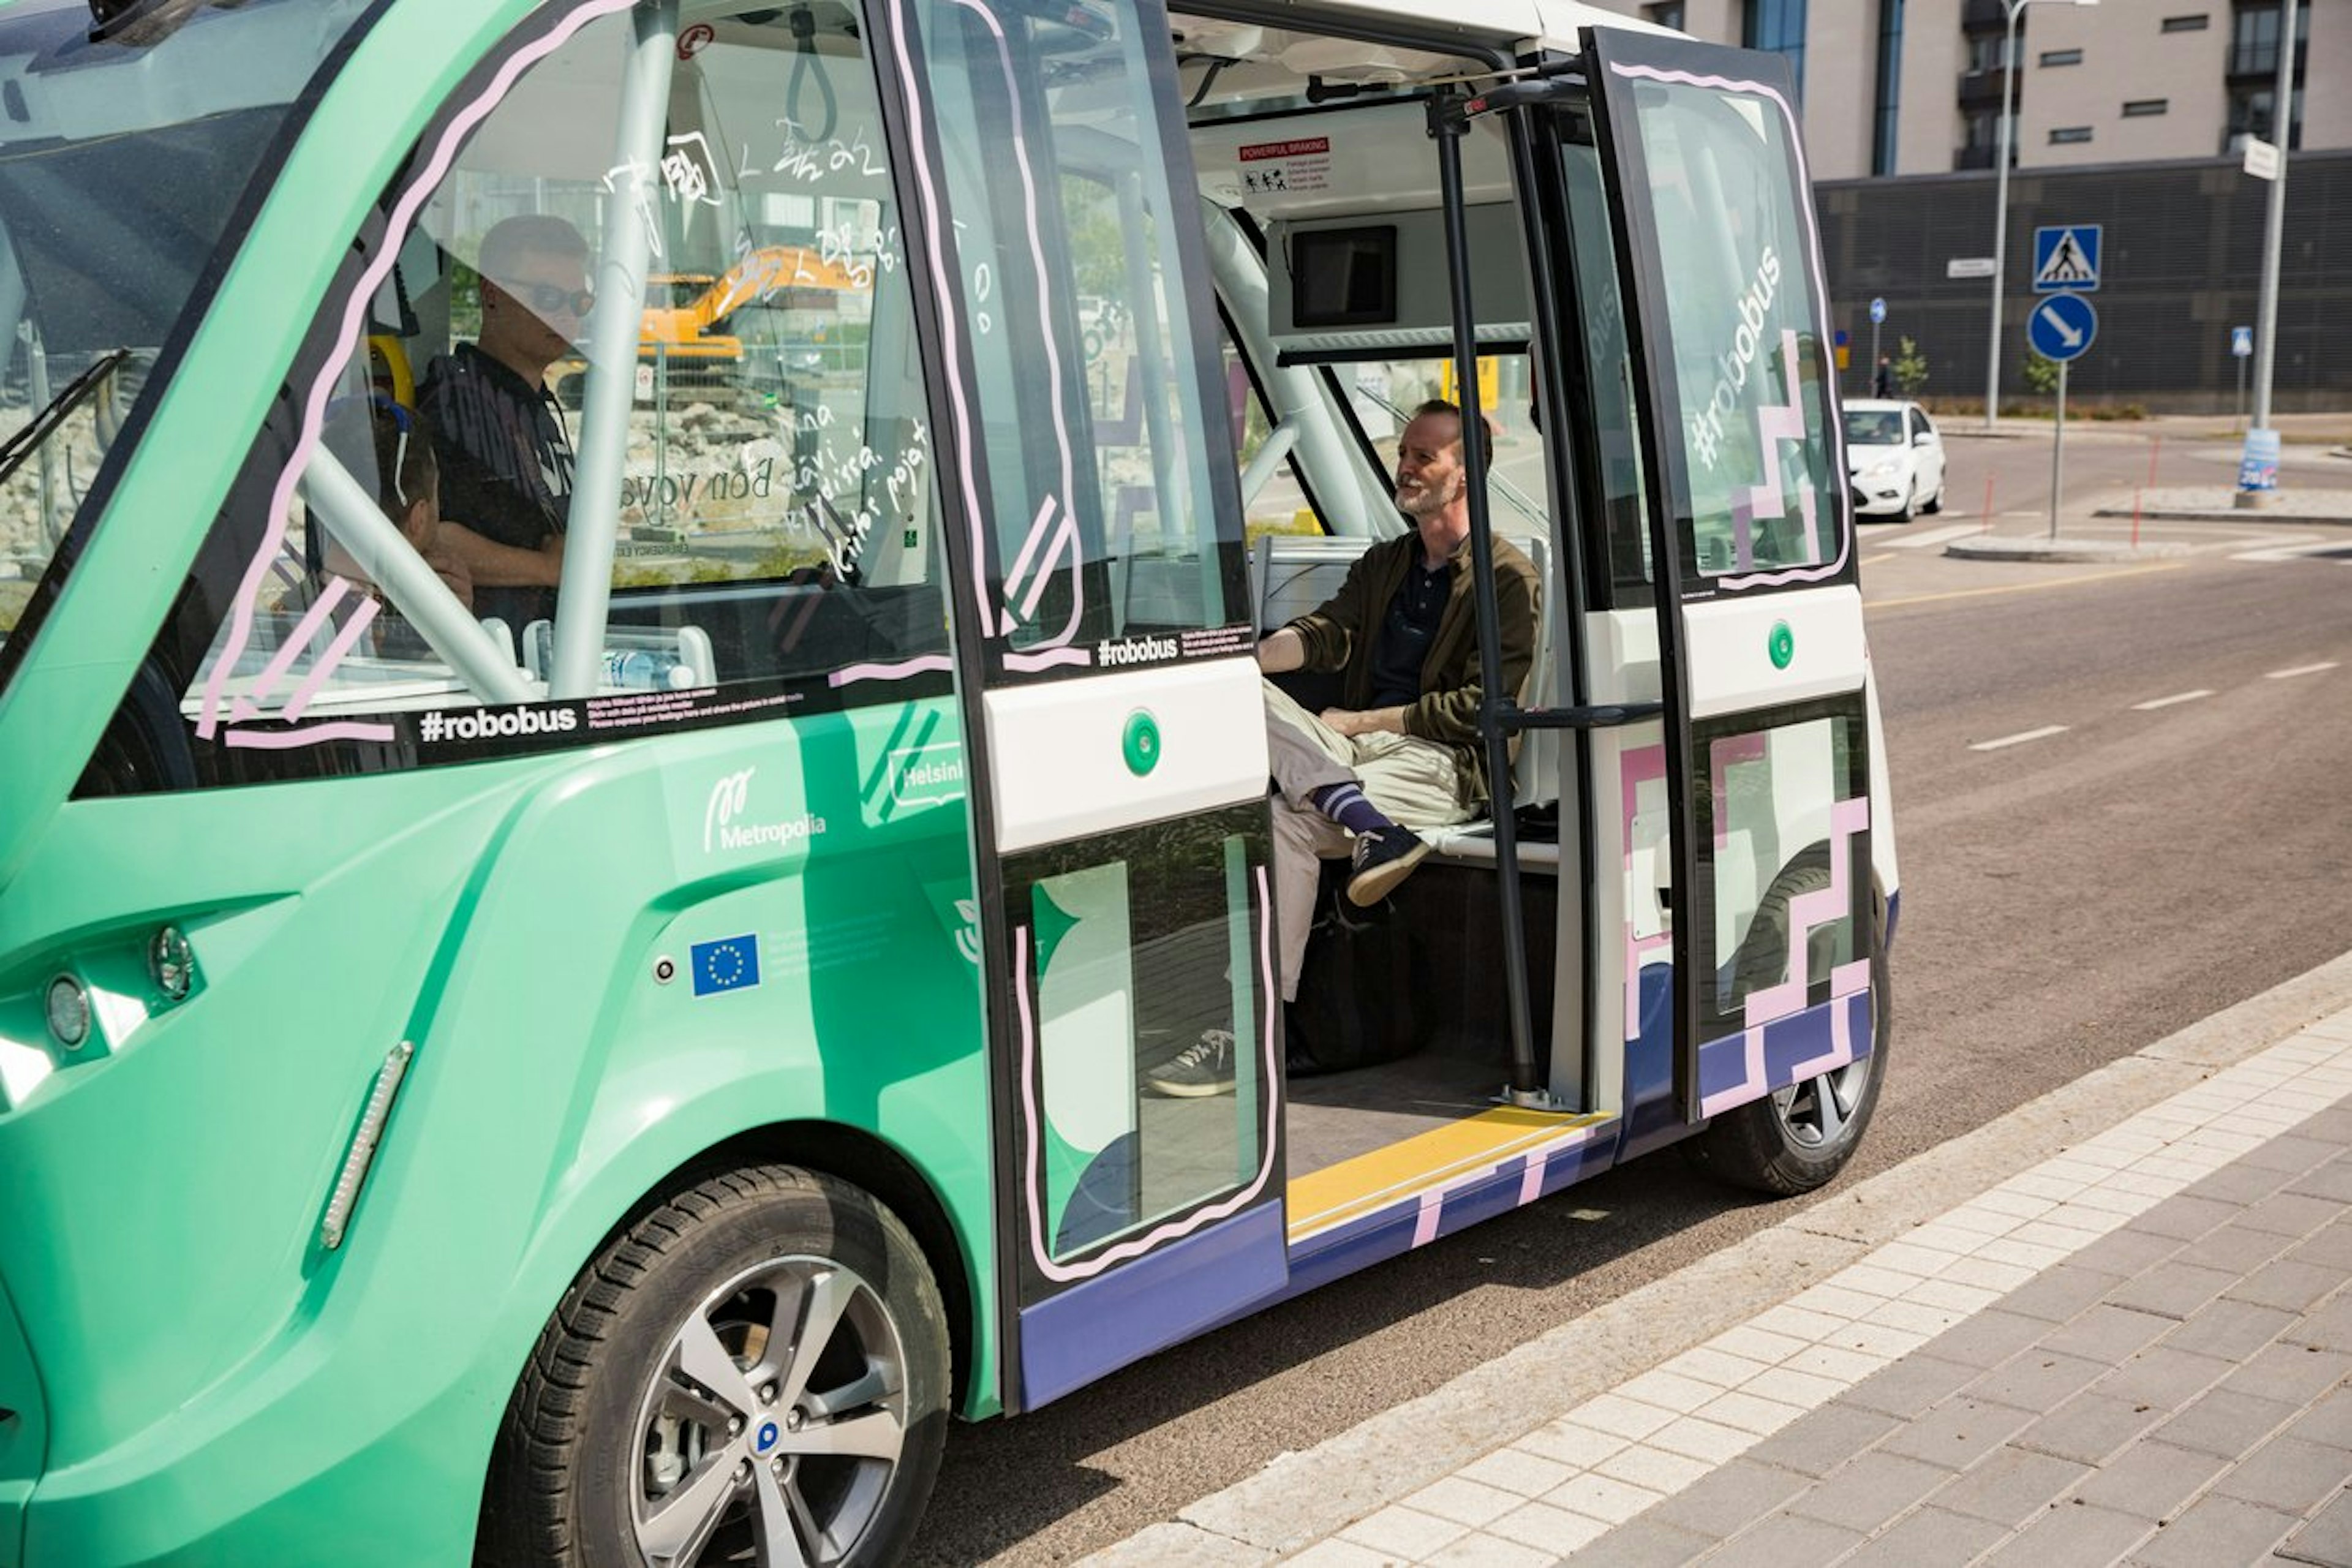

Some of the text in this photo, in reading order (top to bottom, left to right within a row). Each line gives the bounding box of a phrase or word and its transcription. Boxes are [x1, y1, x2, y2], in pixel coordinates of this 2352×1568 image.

[1243, 140, 1327, 159] POWERFUL BRAKING
[1692, 246, 1781, 470] #robobus
[1098, 635, 1178, 667] #robobus
[419, 705, 577, 742] #robobus
[903, 760, 963, 788] Helsin
[720, 813, 826, 850] Metropolia
